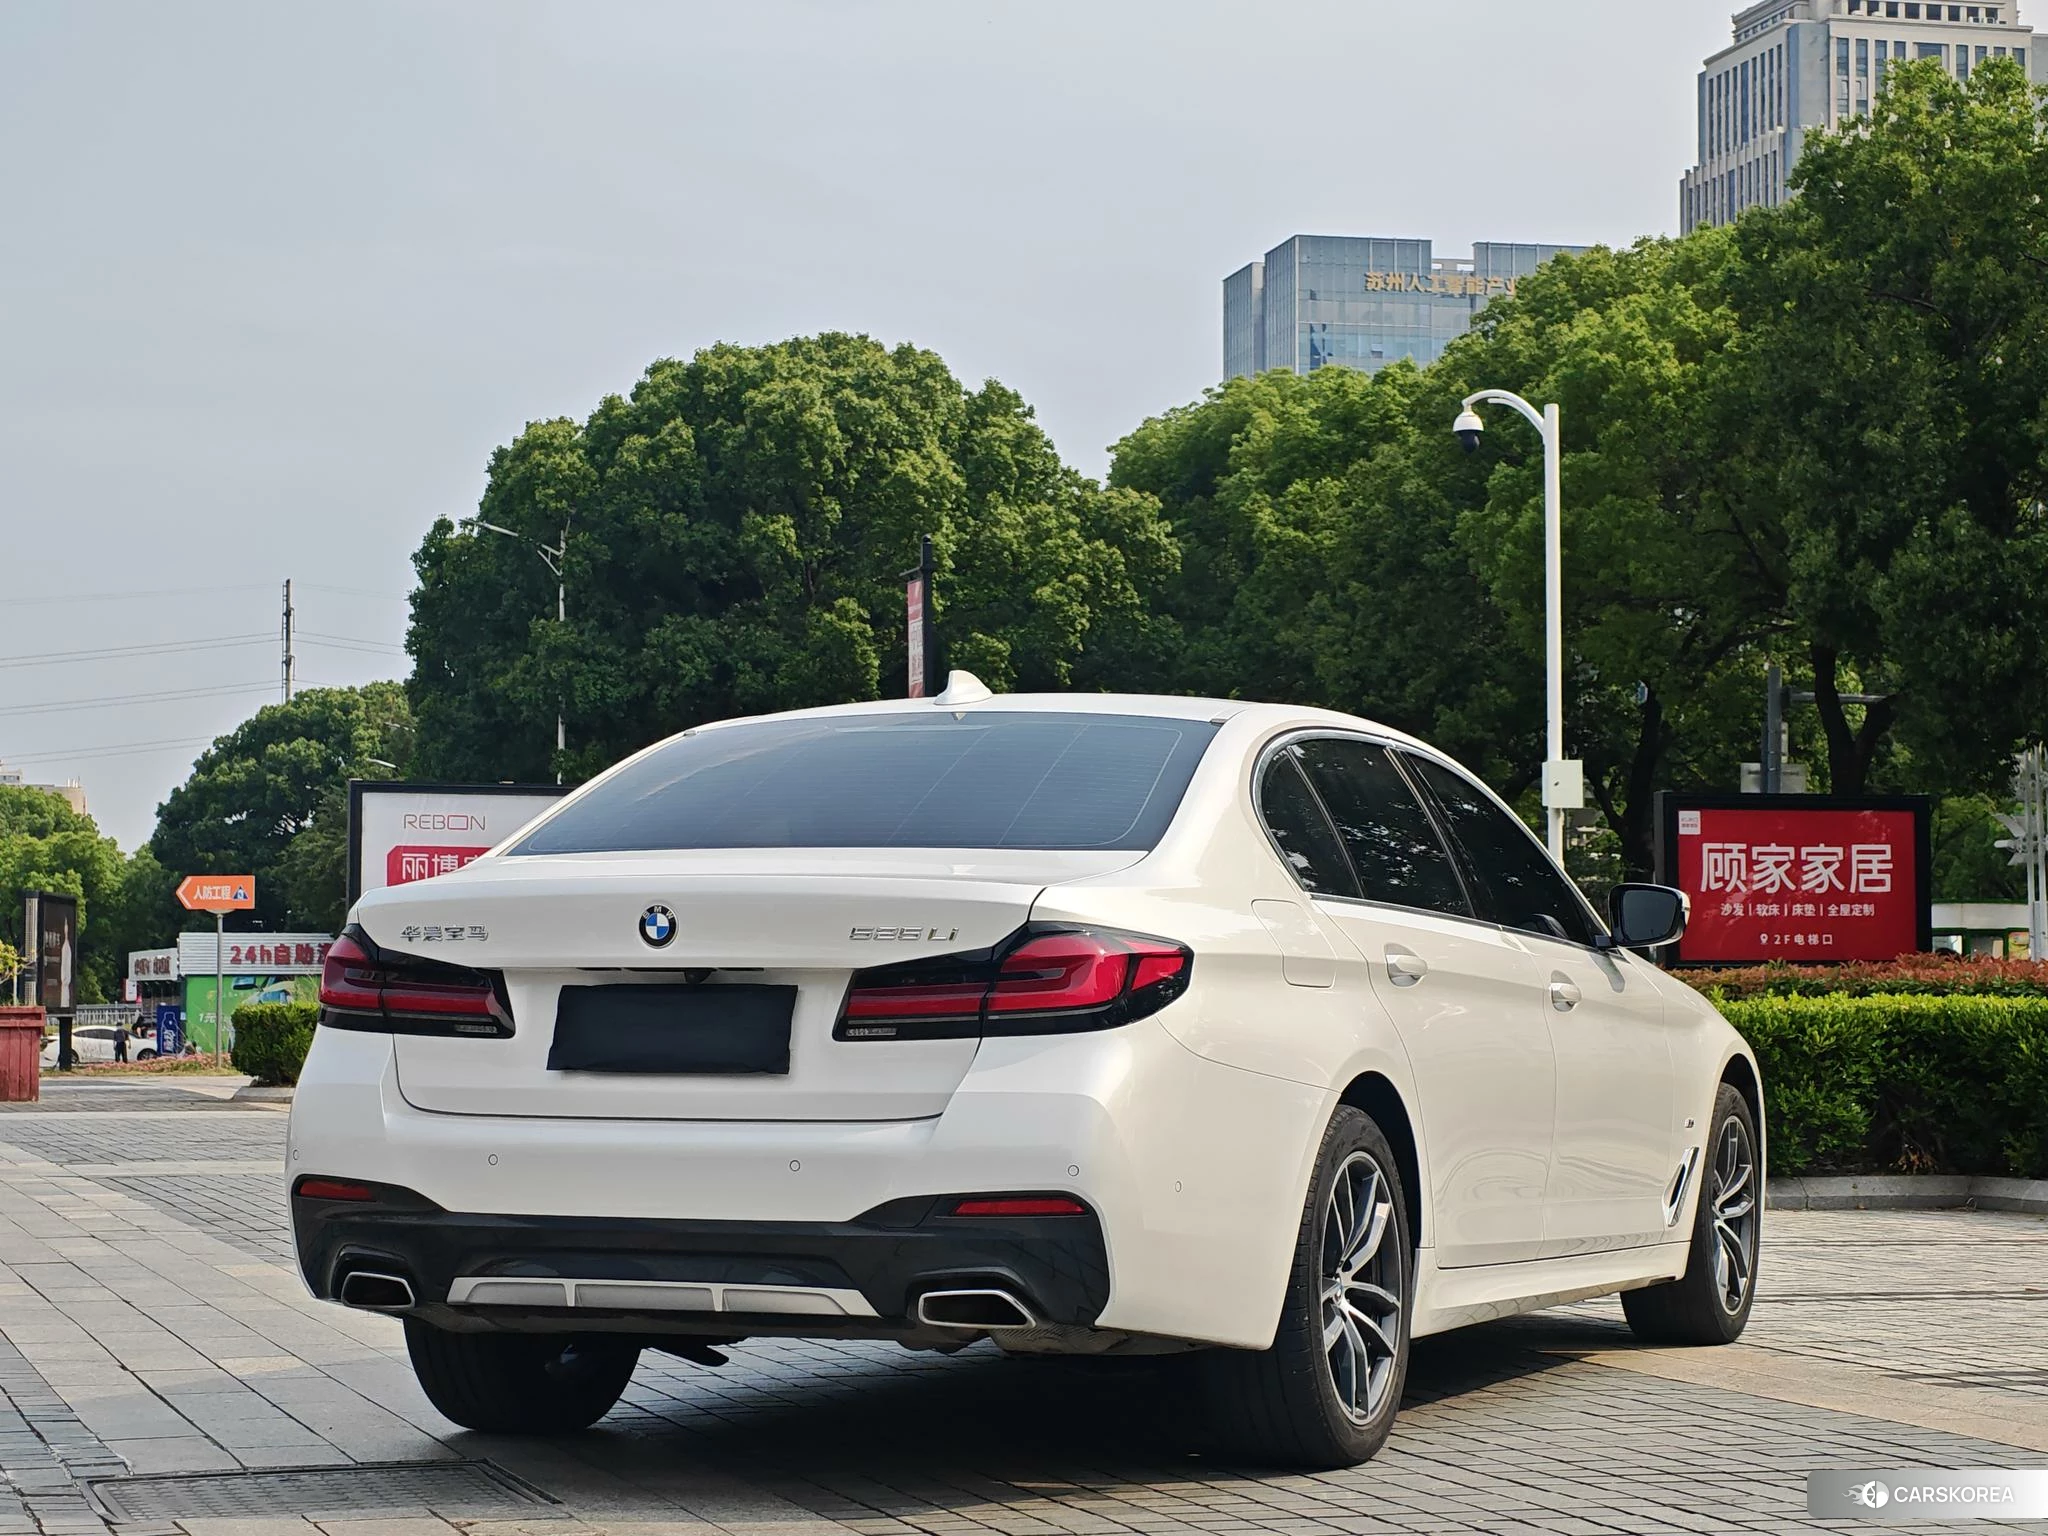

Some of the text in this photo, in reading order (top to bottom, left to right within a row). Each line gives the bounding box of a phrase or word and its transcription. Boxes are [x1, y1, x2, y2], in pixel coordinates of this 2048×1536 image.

[403, 814, 486, 830] REBON
[1700, 843, 1894, 894] 顾家家居
[193, 885, 231, 900] 人防工程
[642, 906, 674, 920] BMW
[1720, 903, 1875, 917] 沙发 软床 床垫 全屋定制
